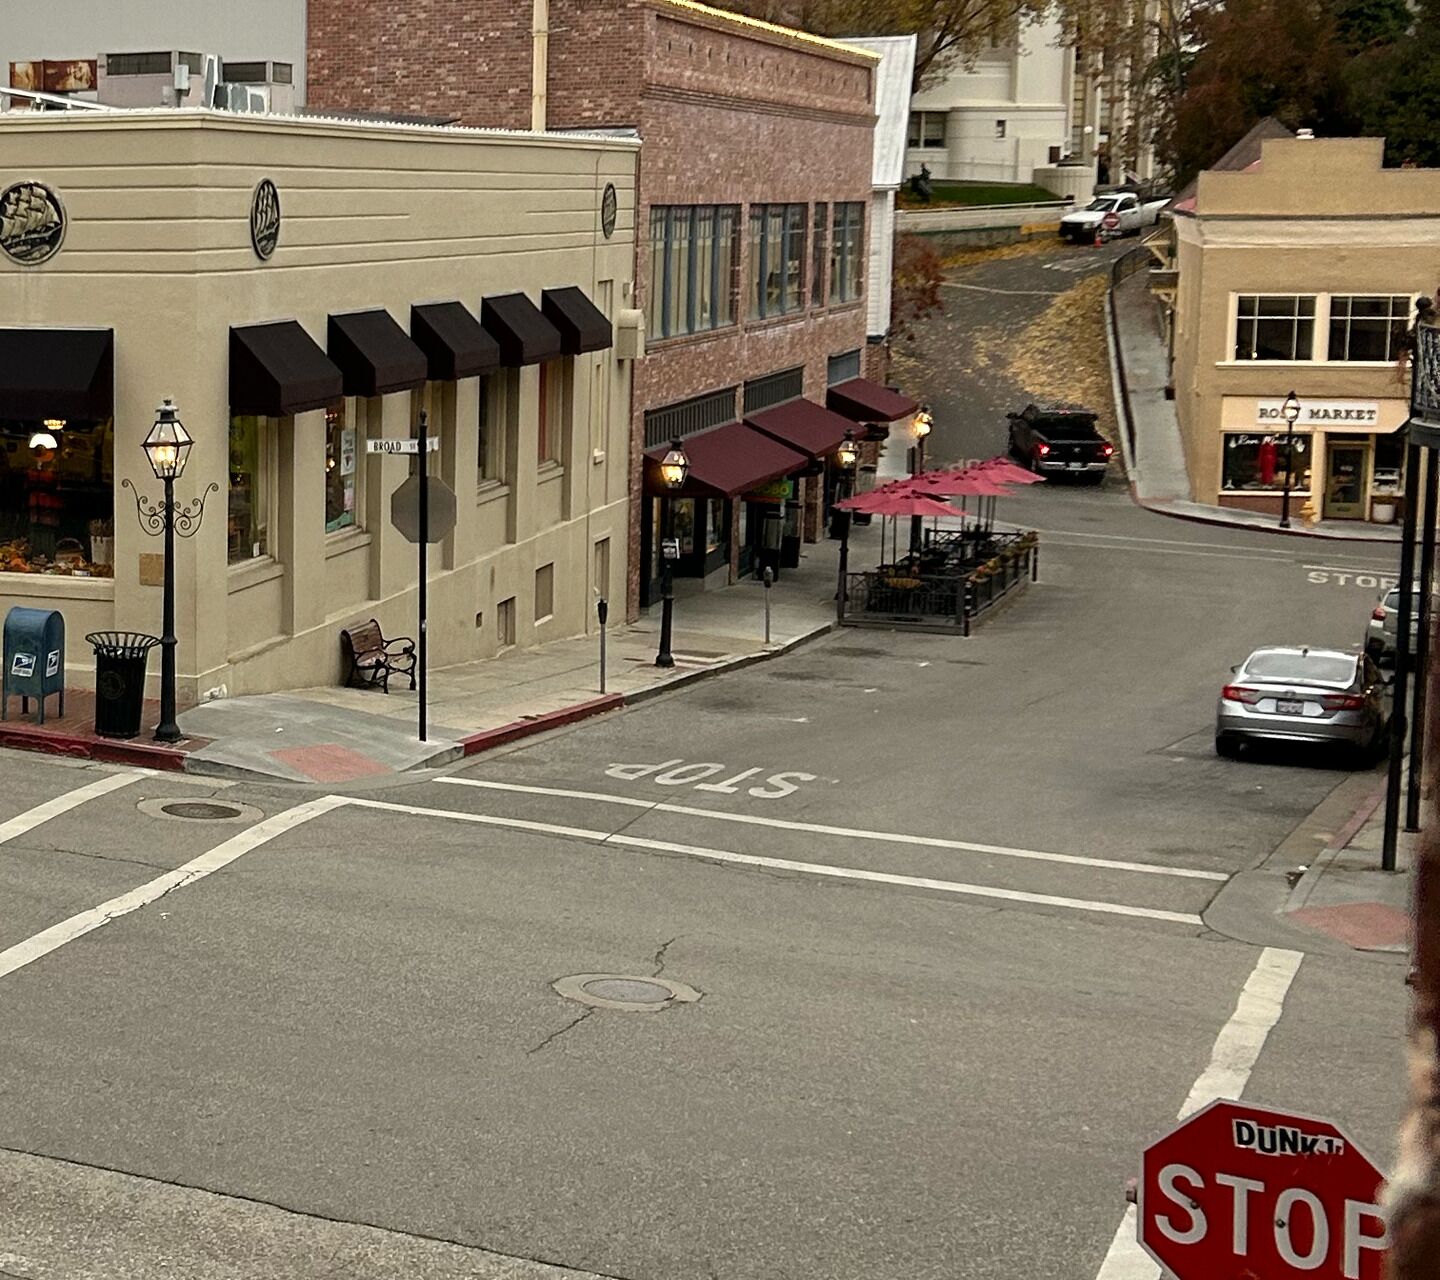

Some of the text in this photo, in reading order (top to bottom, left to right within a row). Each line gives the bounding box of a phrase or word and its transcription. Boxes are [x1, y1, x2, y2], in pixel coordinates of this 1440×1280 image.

[1309, 409, 1377, 420] MARKET
[373, 441, 402, 452] BROAD
[604, 759, 818, 799] STOP
[1154, 1163, 1389, 1280] STOP
